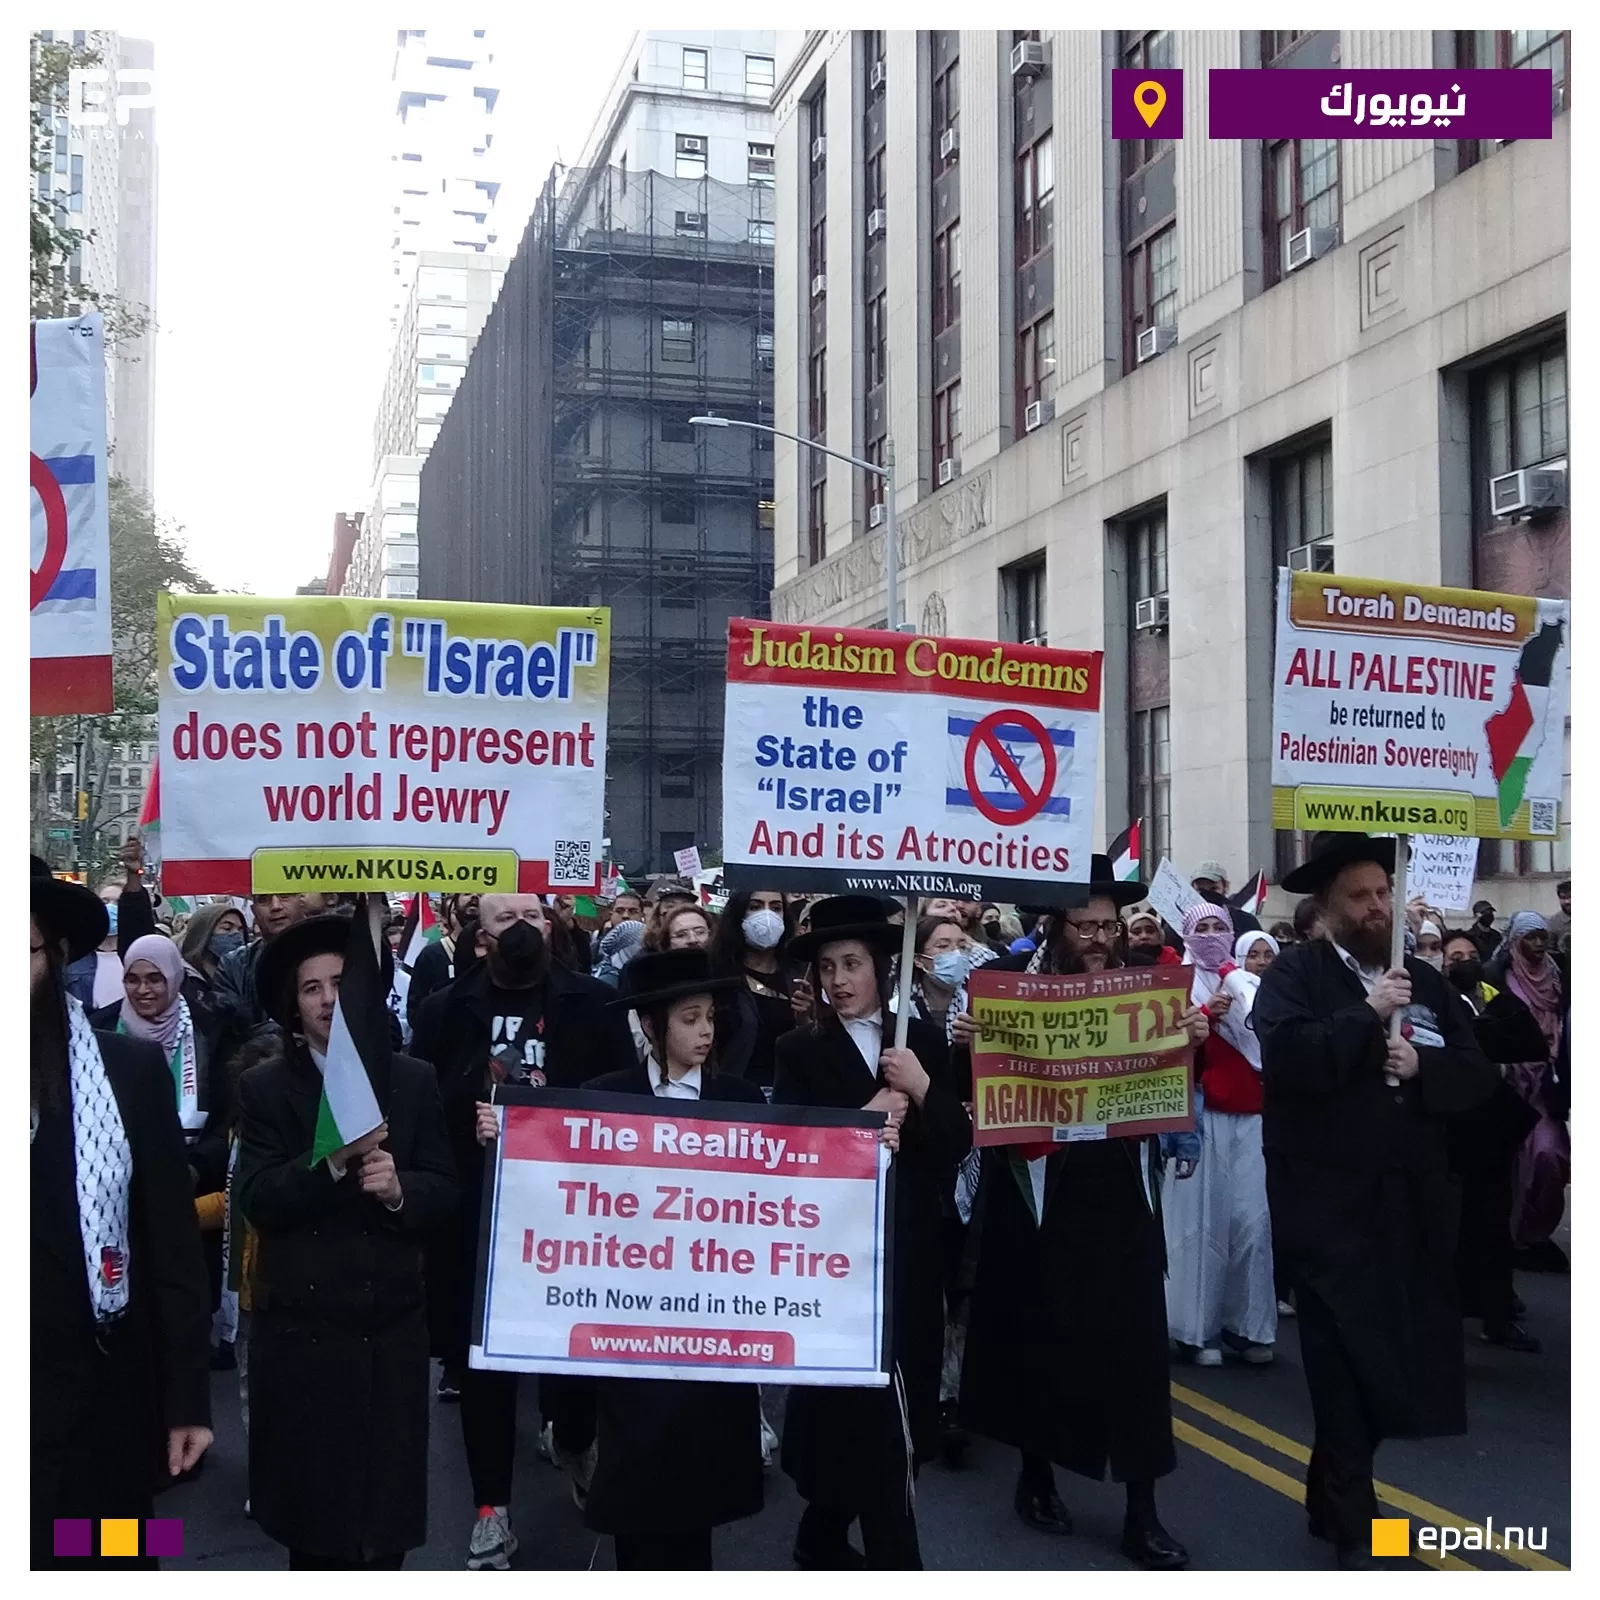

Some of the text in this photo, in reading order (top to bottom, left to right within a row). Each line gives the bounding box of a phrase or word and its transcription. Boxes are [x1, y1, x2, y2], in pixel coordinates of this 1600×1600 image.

[1323, 588, 1517, 634] Torah Demands
[172, 616, 596, 700] State of "Israel"
[743, 627, 1089, 695] Judaism Condemns
[1284, 647, 1497, 702] ALL PALESTINE
[802, 695, 864, 730] the
[1330, 699, 1447, 732] be returned to
[172, 711, 596, 773] does not represent
[755, 734, 909, 774] State of
[1280, 731, 1479, 780] Palestinian Sovereignty
[263, 772, 511, 836] world Jewry
[1305, 800, 1469, 831] www.nkusa.org
[749, 820, 1070, 873] And its Atrocities
[282, 858, 499, 886] www.NKUSA.org
[846, 874, 983, 901] www.NKUSA.org
[1042, 1007, 1108, 1030] הכיבוש
[1112, 995, 1184, 1044] נגד
[1044, 1031, 1080, 1056] ארץ
[1085, 1028, 1108, 1048] על
[1007, 1055, 1160, 1077] THE JEWISH NATION
[984, 1082, 1089, 1126] AGAINST
[1096, 1087, 1185, 1110] OCCUPATION
[1097, 1074, 1184, 1097] THE ZIONISTS
[1095, 1098, 1185, 1122] OF PALESTINE
[562, 1116, 820, 1169] The Reality...
[558, 1180, 822, 1230] The Zionists
[521, 1228, 852, 1279] Ignited the Fire
[545, 1285, 822, 1319] Both Now and in the Past
[590, 1333, 775, 1361] www.NKUSA.org
